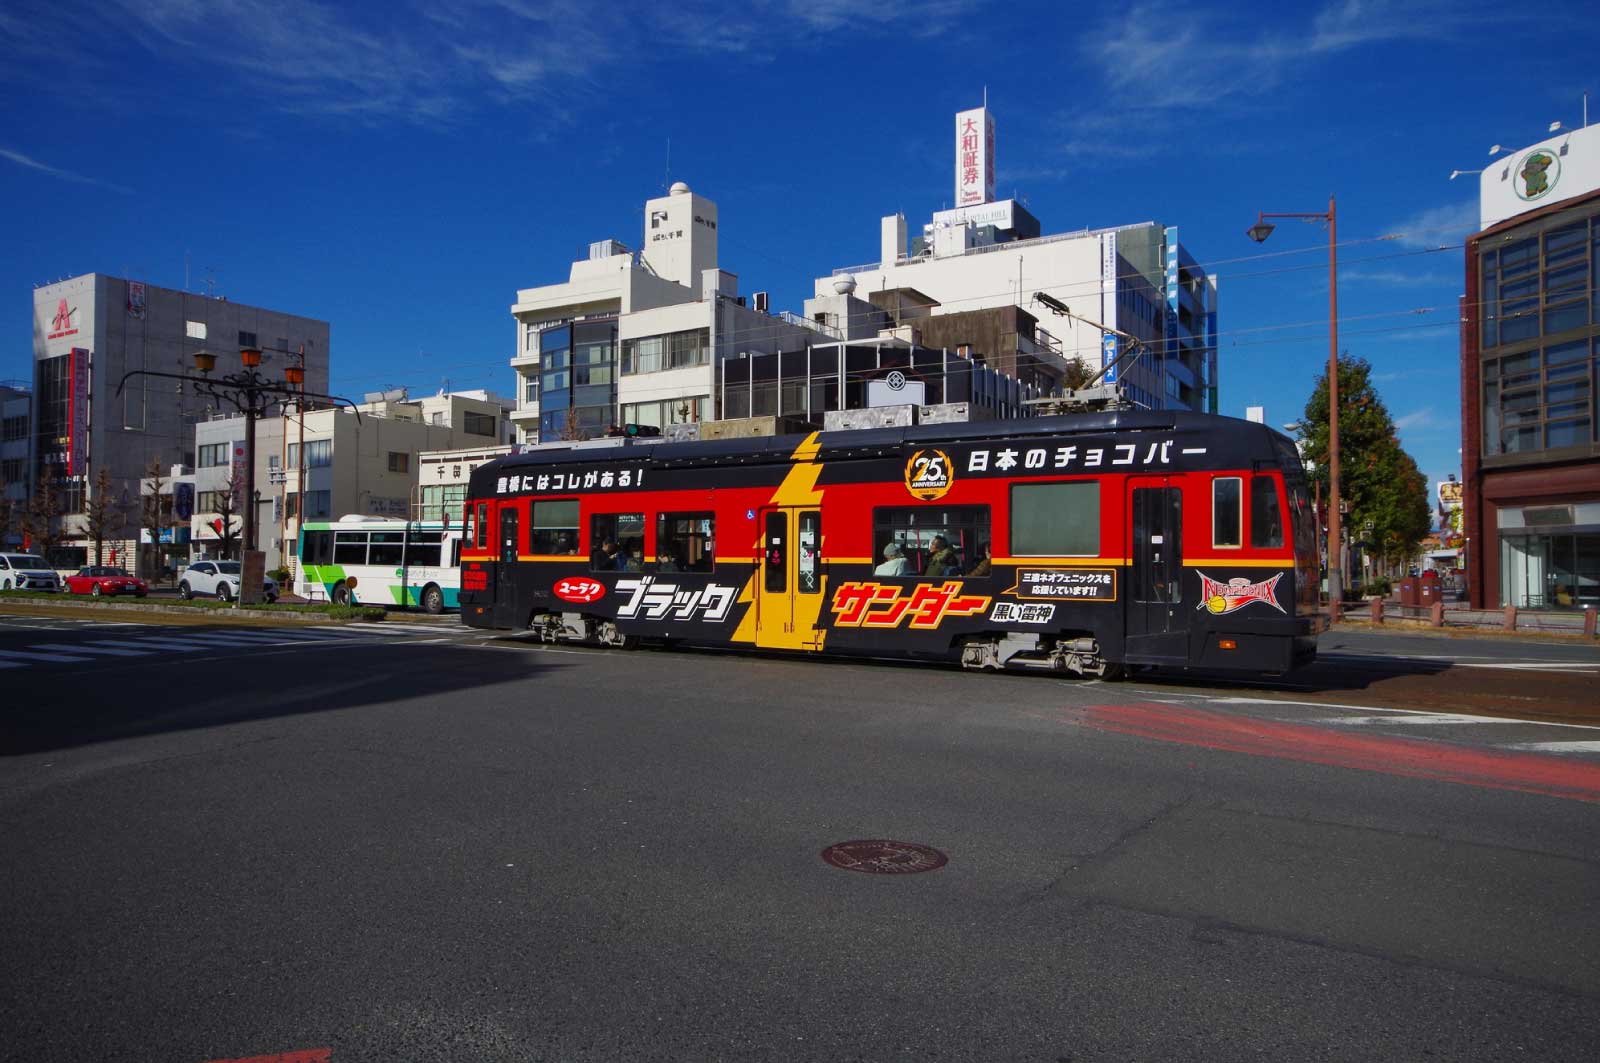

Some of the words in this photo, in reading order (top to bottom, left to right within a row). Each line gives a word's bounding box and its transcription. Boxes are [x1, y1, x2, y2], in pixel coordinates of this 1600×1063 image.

[962, 118, 979, 185] 大和証券
[912, 457, 947, 482] 25th
[968, 440, 1206, 471] 日本のチョコバー
[559, 582, 600, 595] ユーラク
[1022, 573, 1111, 584] 三遠ネオフェニックスを
[615, 576, 739, 622] ブラック
[831, 581, 992, 629] サンダー
[993, 603, 1053, 623] 黒い雷神
